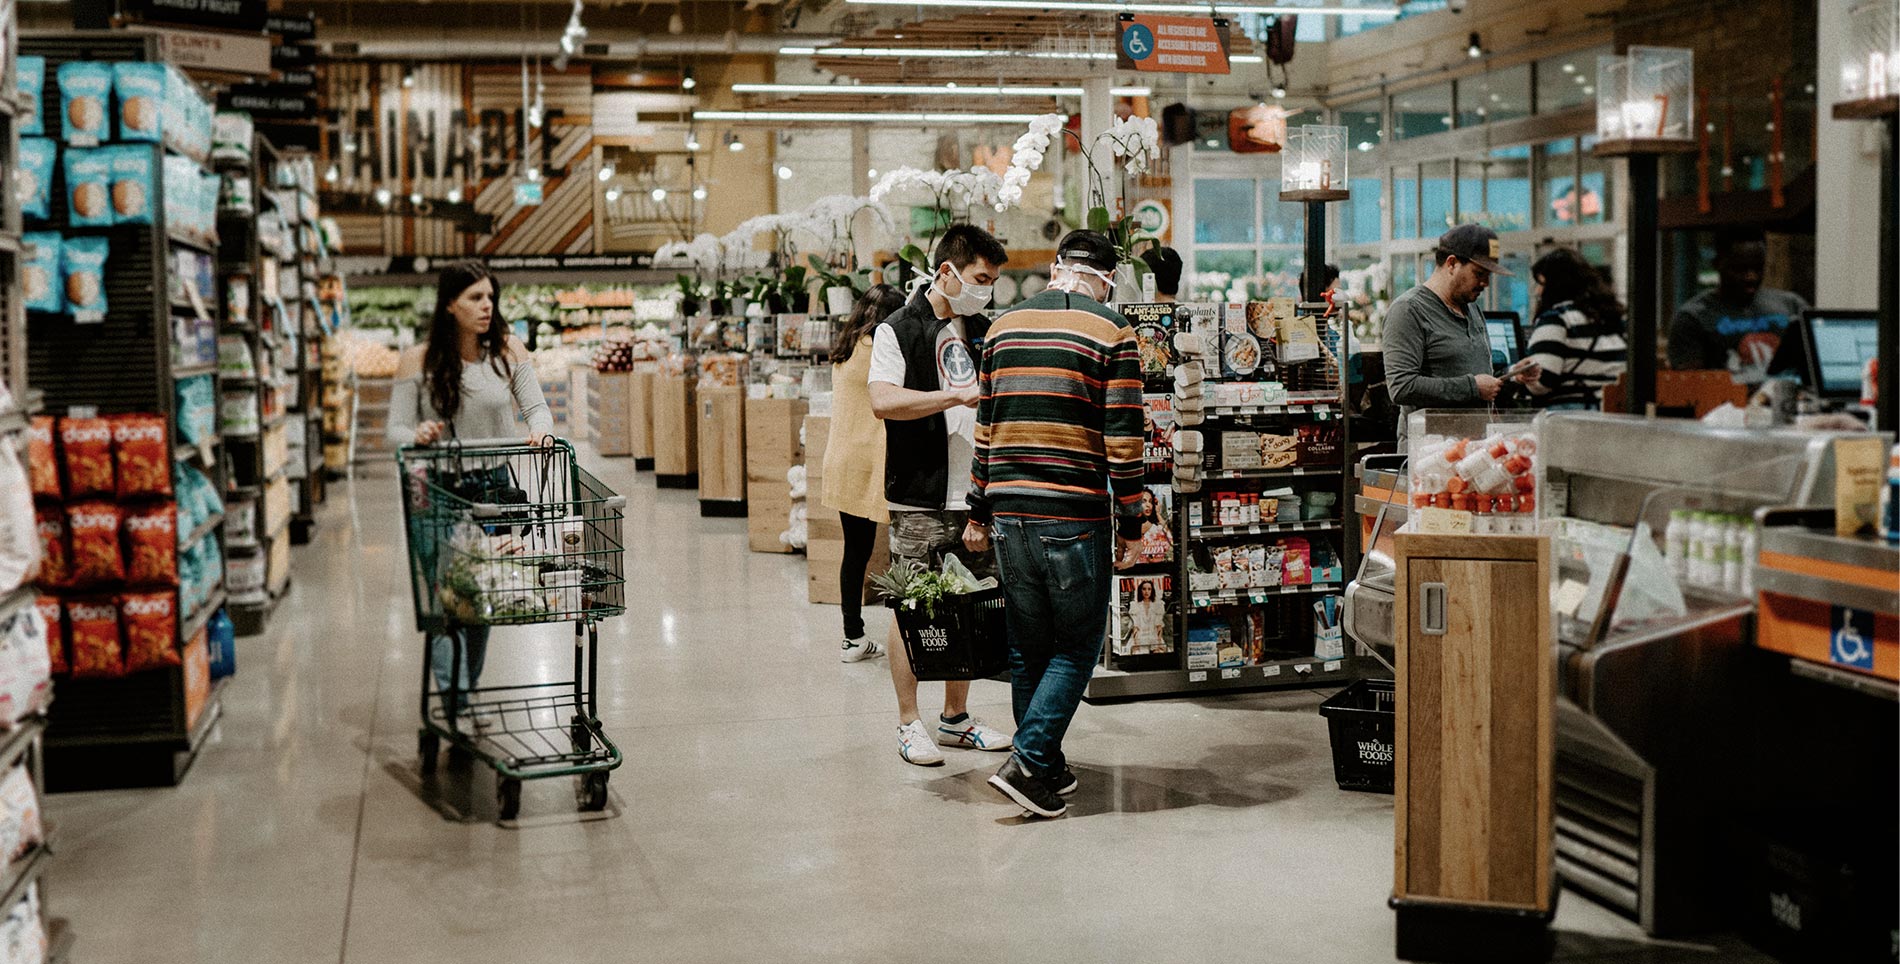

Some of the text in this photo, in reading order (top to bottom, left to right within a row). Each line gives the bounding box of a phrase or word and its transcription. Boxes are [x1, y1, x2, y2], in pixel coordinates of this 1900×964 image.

[1654, 93, 1668, 138] 7
[1124, 307, 1172, 315] PLANT-BASED
[62, 427, 111, 444] dang
[114, 426, 162, 443] dang
[1273, 438, 1290, 449] dang
[1273, 454, 1290, 465] dang
[70, 513, 117, 531] dang
[125, 516, 171, 533] dang
[69, 602, 117, 621] dang
[123, 599, 169, 617] dang
[918, 628, 947, 638] WHOLE
[921, 637, 948, 647] FOODS
[1357, 741, 1393, 753] WHOLE
[1359, 750, 1393, 761] FOODS
